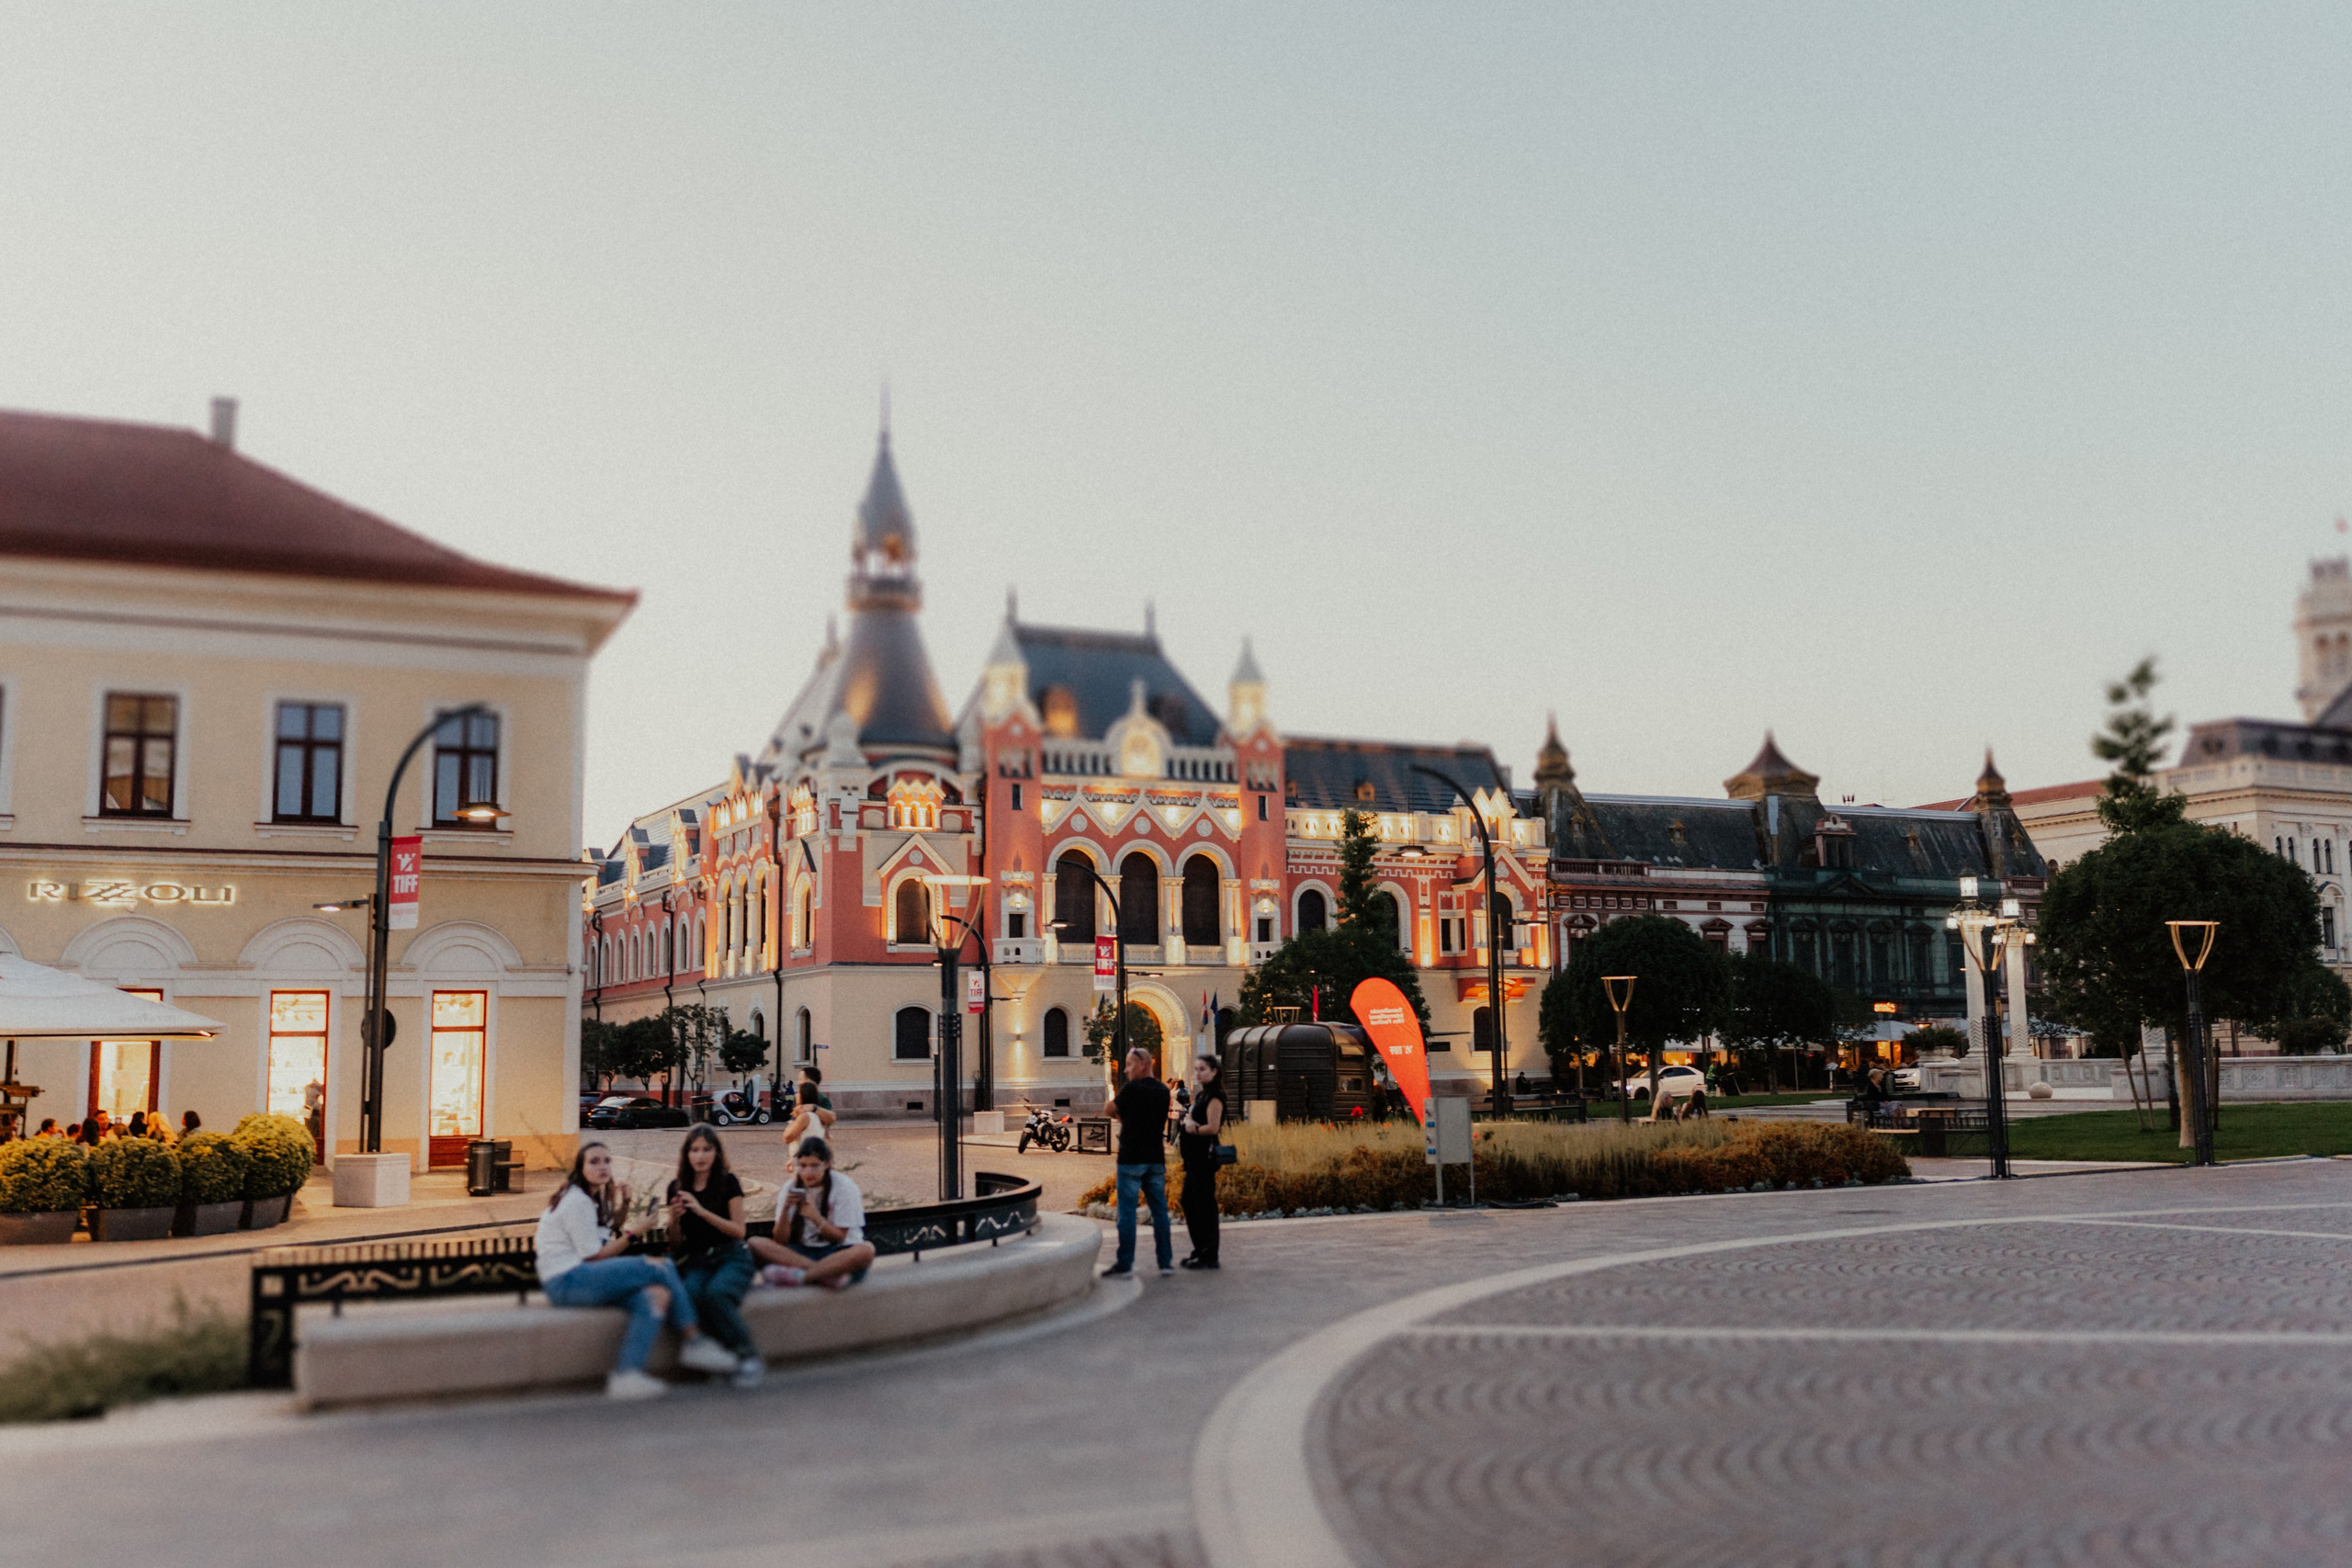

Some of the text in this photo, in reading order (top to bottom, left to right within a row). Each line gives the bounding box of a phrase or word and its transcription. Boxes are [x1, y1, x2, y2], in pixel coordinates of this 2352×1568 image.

[28, 880, 232, 903] RIZZOLI
[393, 874, 418, 894] TIFF
[1096, 958, 1114, 970] TIFF
[970, 988, 983, 997] TIFF
